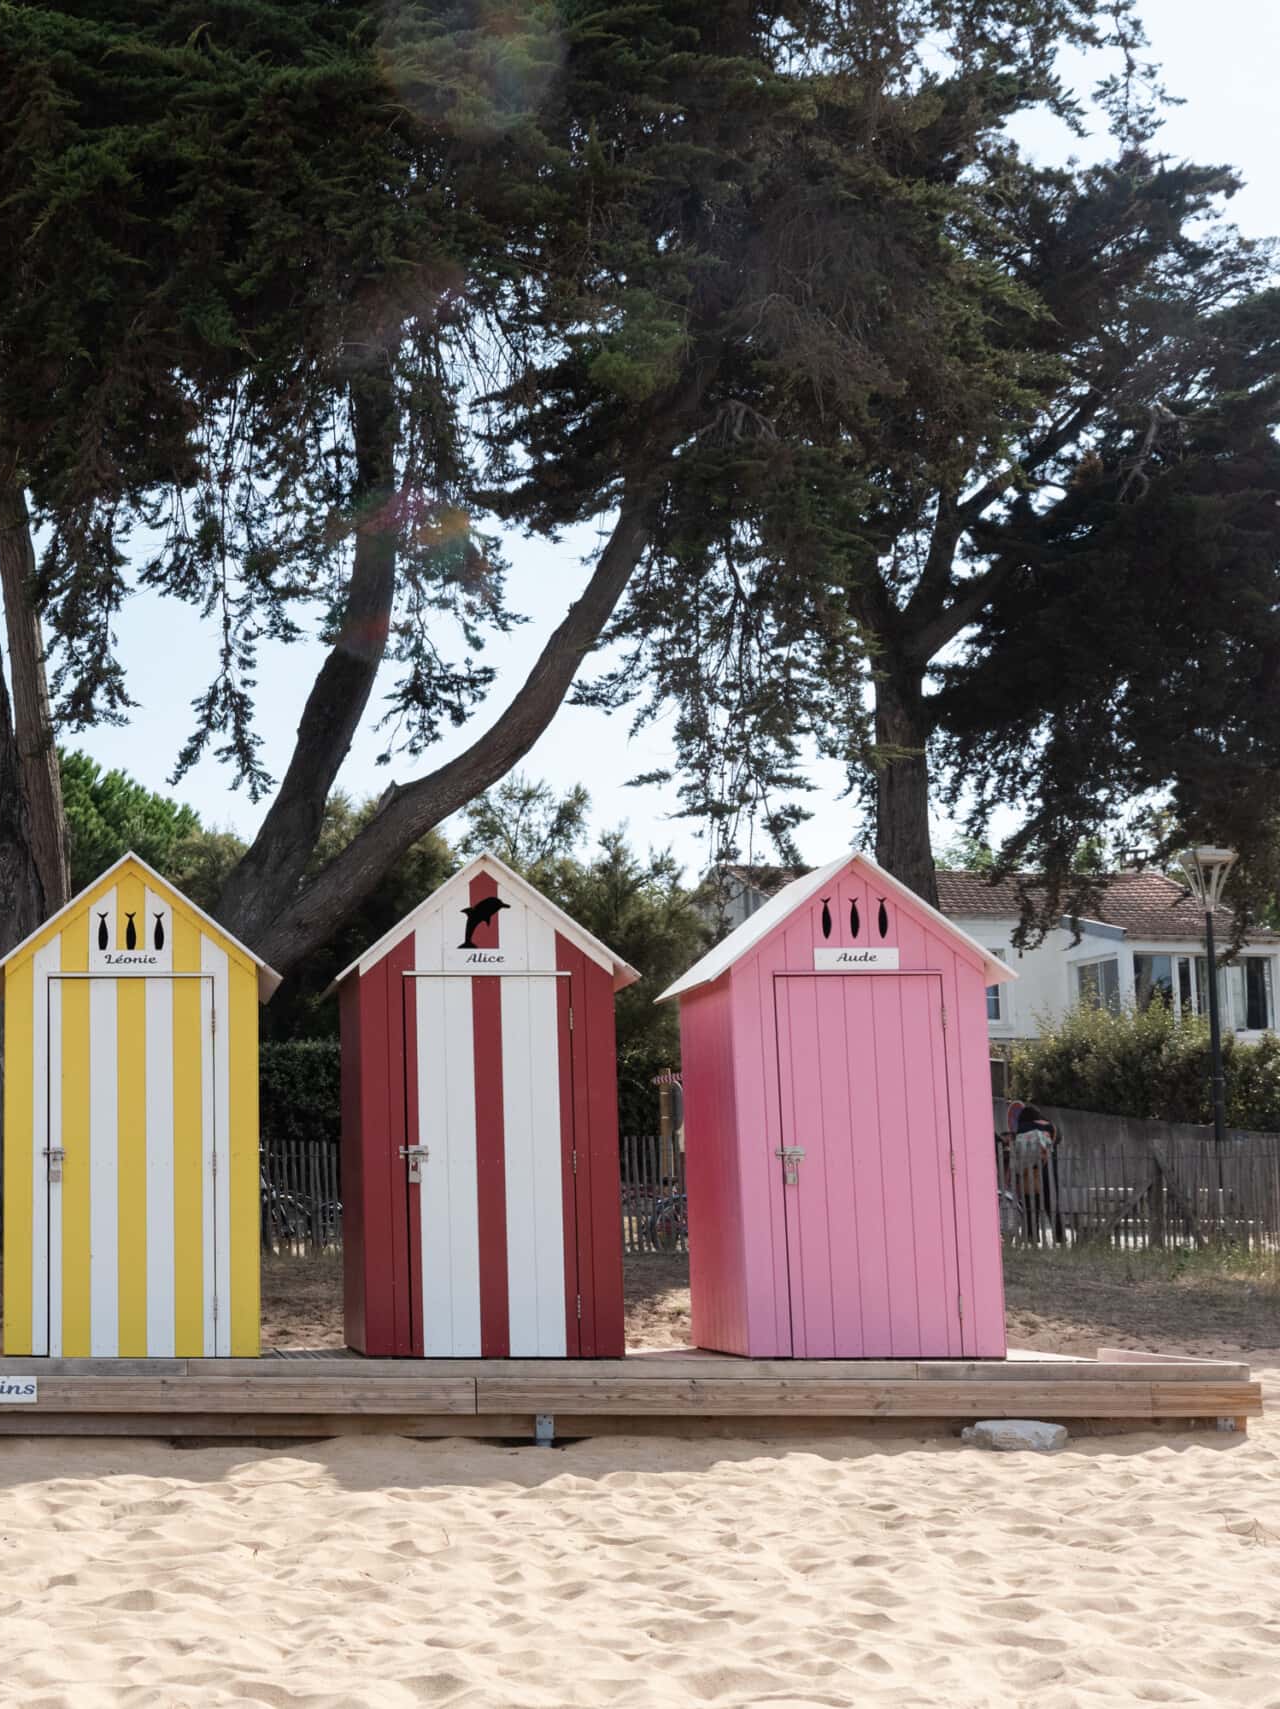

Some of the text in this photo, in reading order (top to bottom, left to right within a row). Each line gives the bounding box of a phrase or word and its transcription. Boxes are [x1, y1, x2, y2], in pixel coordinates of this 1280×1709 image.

[104, 953, 158, 964] Léonie
[465, 952, 505, 963] Alice
[836, 952, 877, 962] Aude
